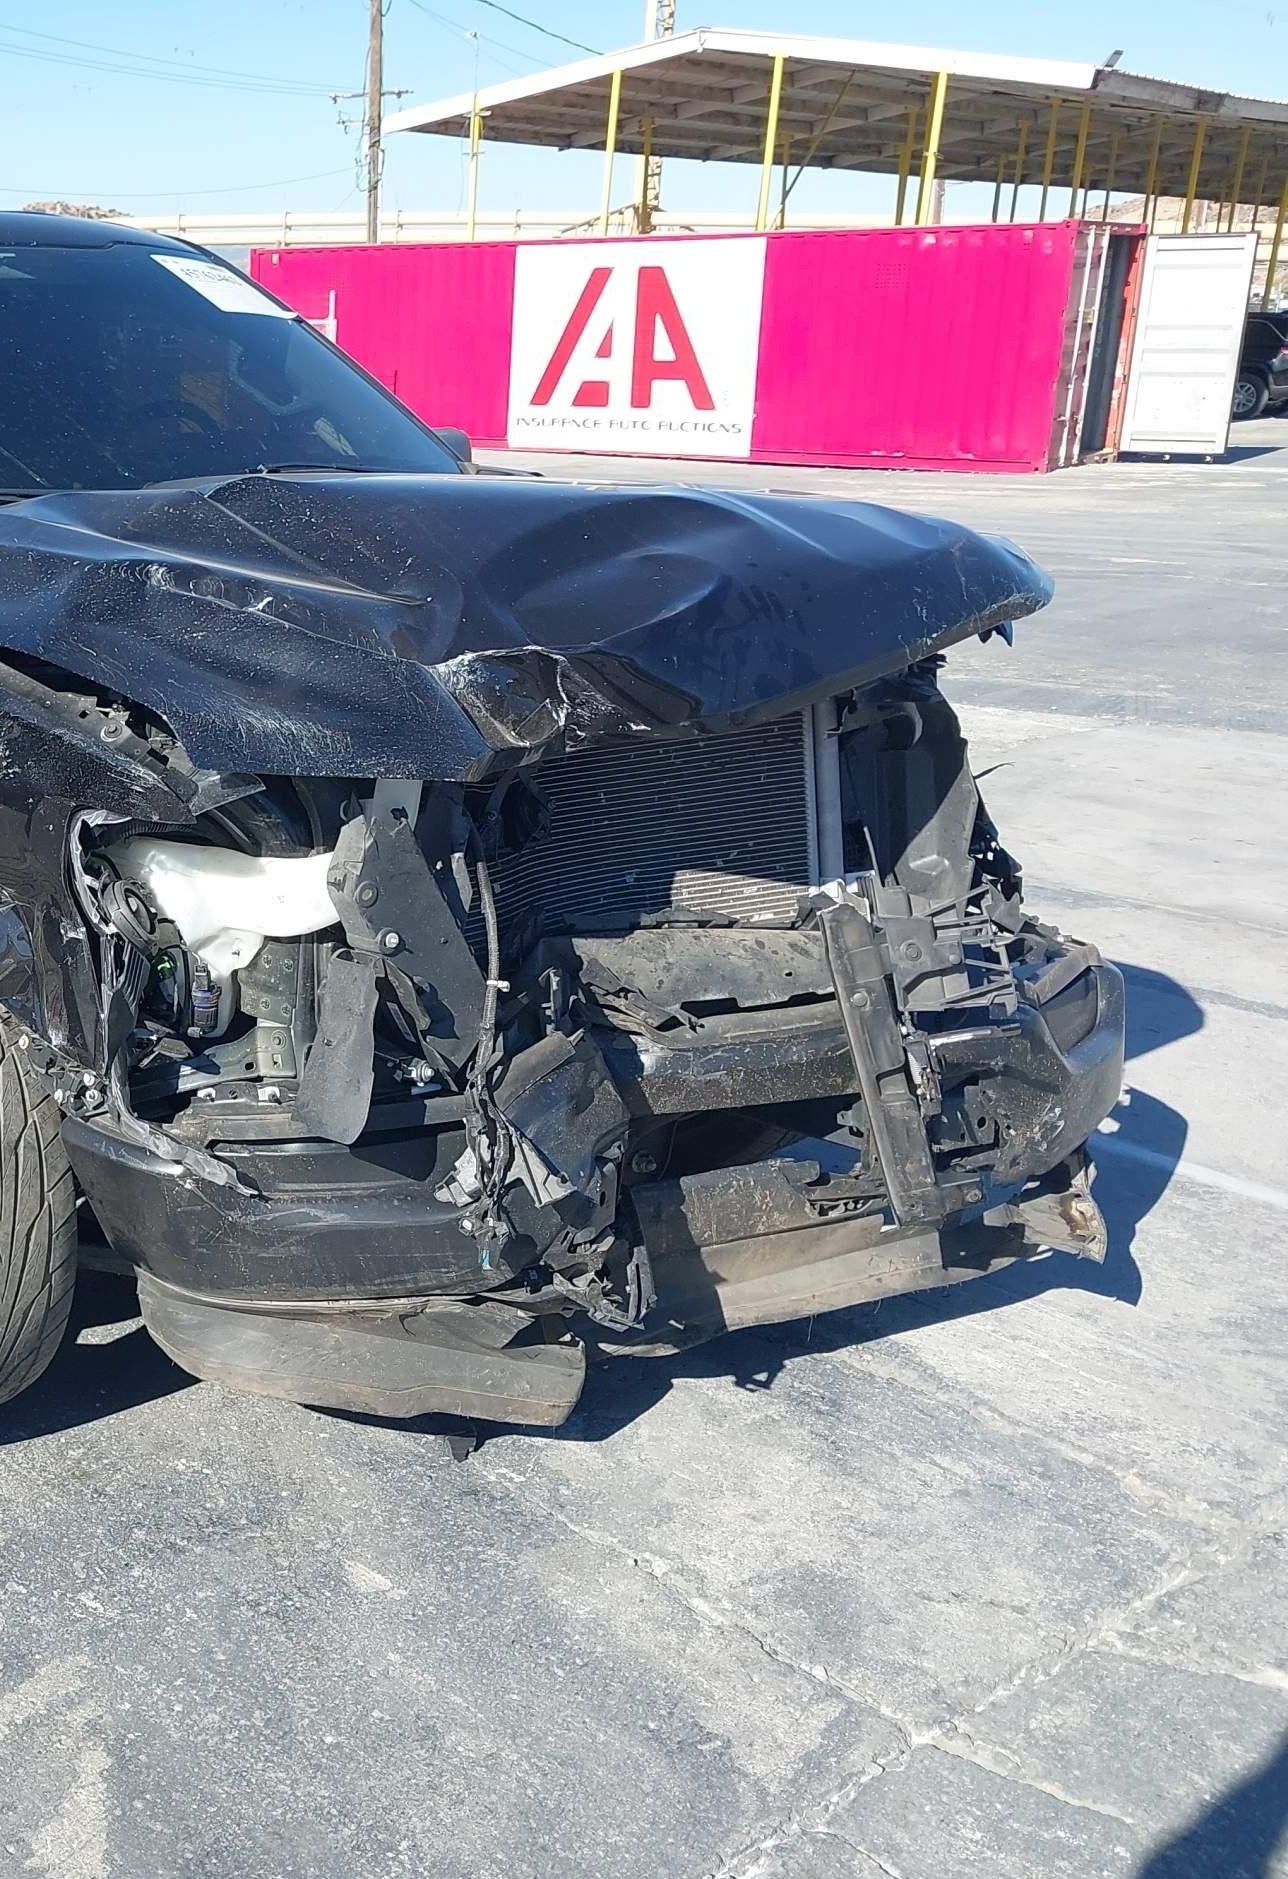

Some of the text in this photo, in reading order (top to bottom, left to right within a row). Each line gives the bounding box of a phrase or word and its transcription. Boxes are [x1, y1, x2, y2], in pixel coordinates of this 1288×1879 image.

[516, 417, 742, 433] INSURANCE AUTO AUCTIONS
